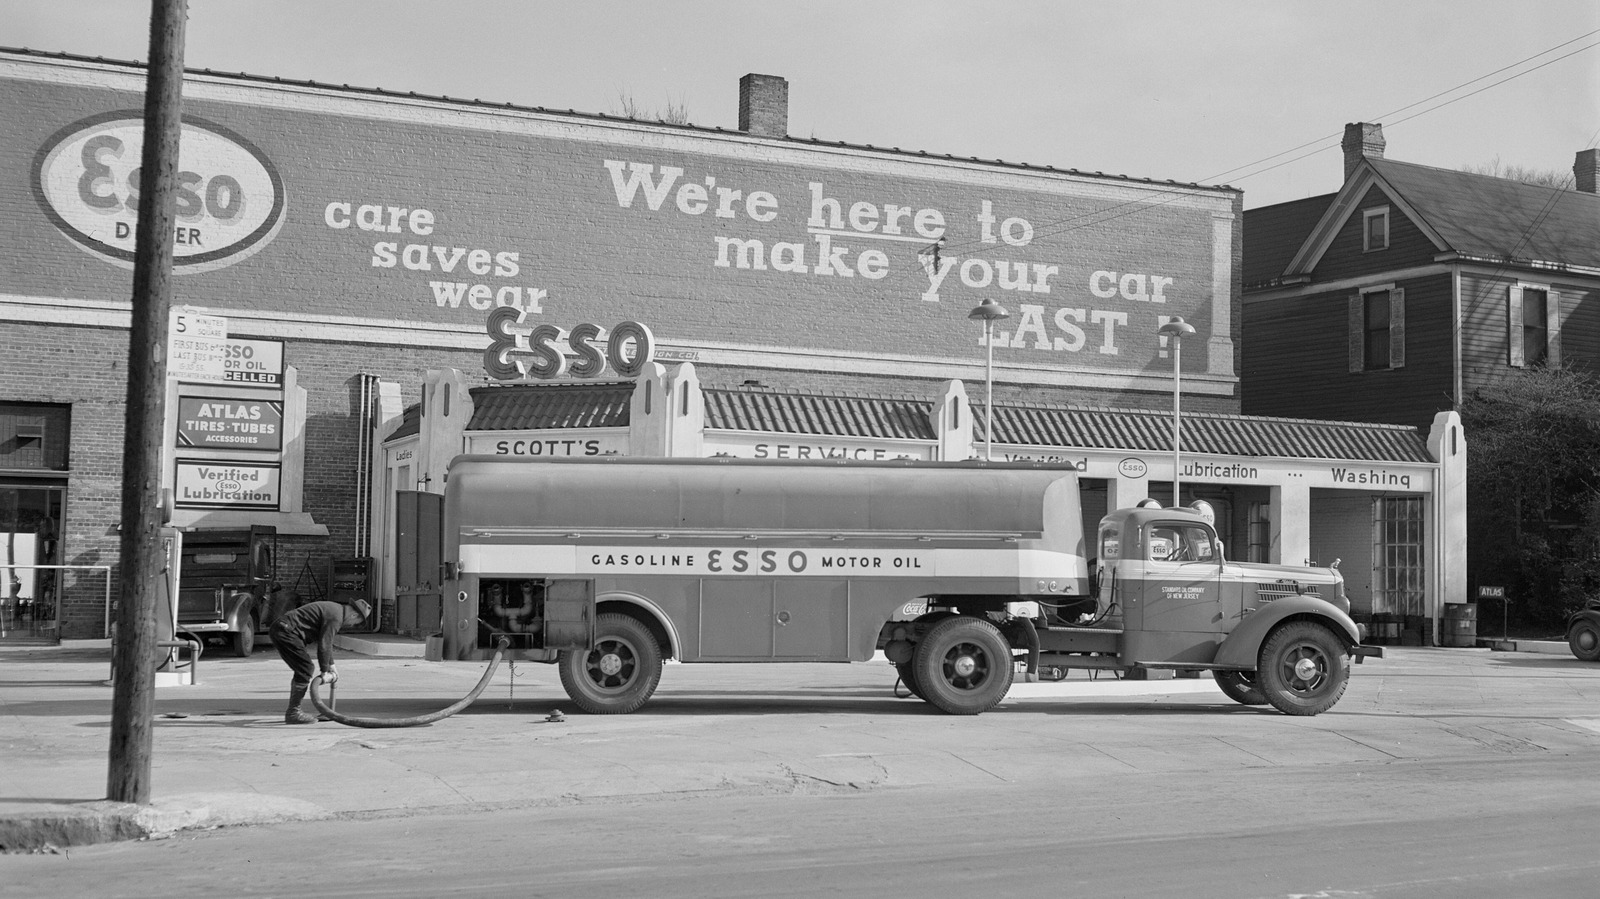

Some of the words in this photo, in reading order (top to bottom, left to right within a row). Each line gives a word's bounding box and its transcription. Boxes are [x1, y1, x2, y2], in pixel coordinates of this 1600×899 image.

[604, 158, 779, 222] We're
[807, 182, 946, 238] here
[977, 199, 1034, 247] to
[324, 201, 435, 235] care
[115, 222, 201, 244] DER
[371, 241, 520, 277] saves
[714, 234, 889, 280] make
[917, 253, 1059, 302] your
[1089, 270, 1173, 304] car
[429, 280, 547, 314] wear
[176, 315, 187, 333] 5
[173, 339, 194, 350] FIRST
[195, 341, 209, 352] BUS
[225, 344, 254, 360] SSO
[245, 361, 267, 371] OIL
[224, 371, 276, 383] CELLED
[197, 403, 262, 420] ATLAS
[205, 434, 258, 444] ACCESSORIES
[395, 450, 413, 461] Ladies
[496, 440, 600, 456] SCOTT'S
[754, 443, 886, 461] SERVICE
[197, 467, 259, 481] Verified
[183, 486, 272, 501] Lubrication
[591, 554, 694, 566] GASOLINE
[822, 557, 881, 568] MOTOR
[893, 557, 921, 568] OIL
[1481, 587, 1502, 597] ATLAS
